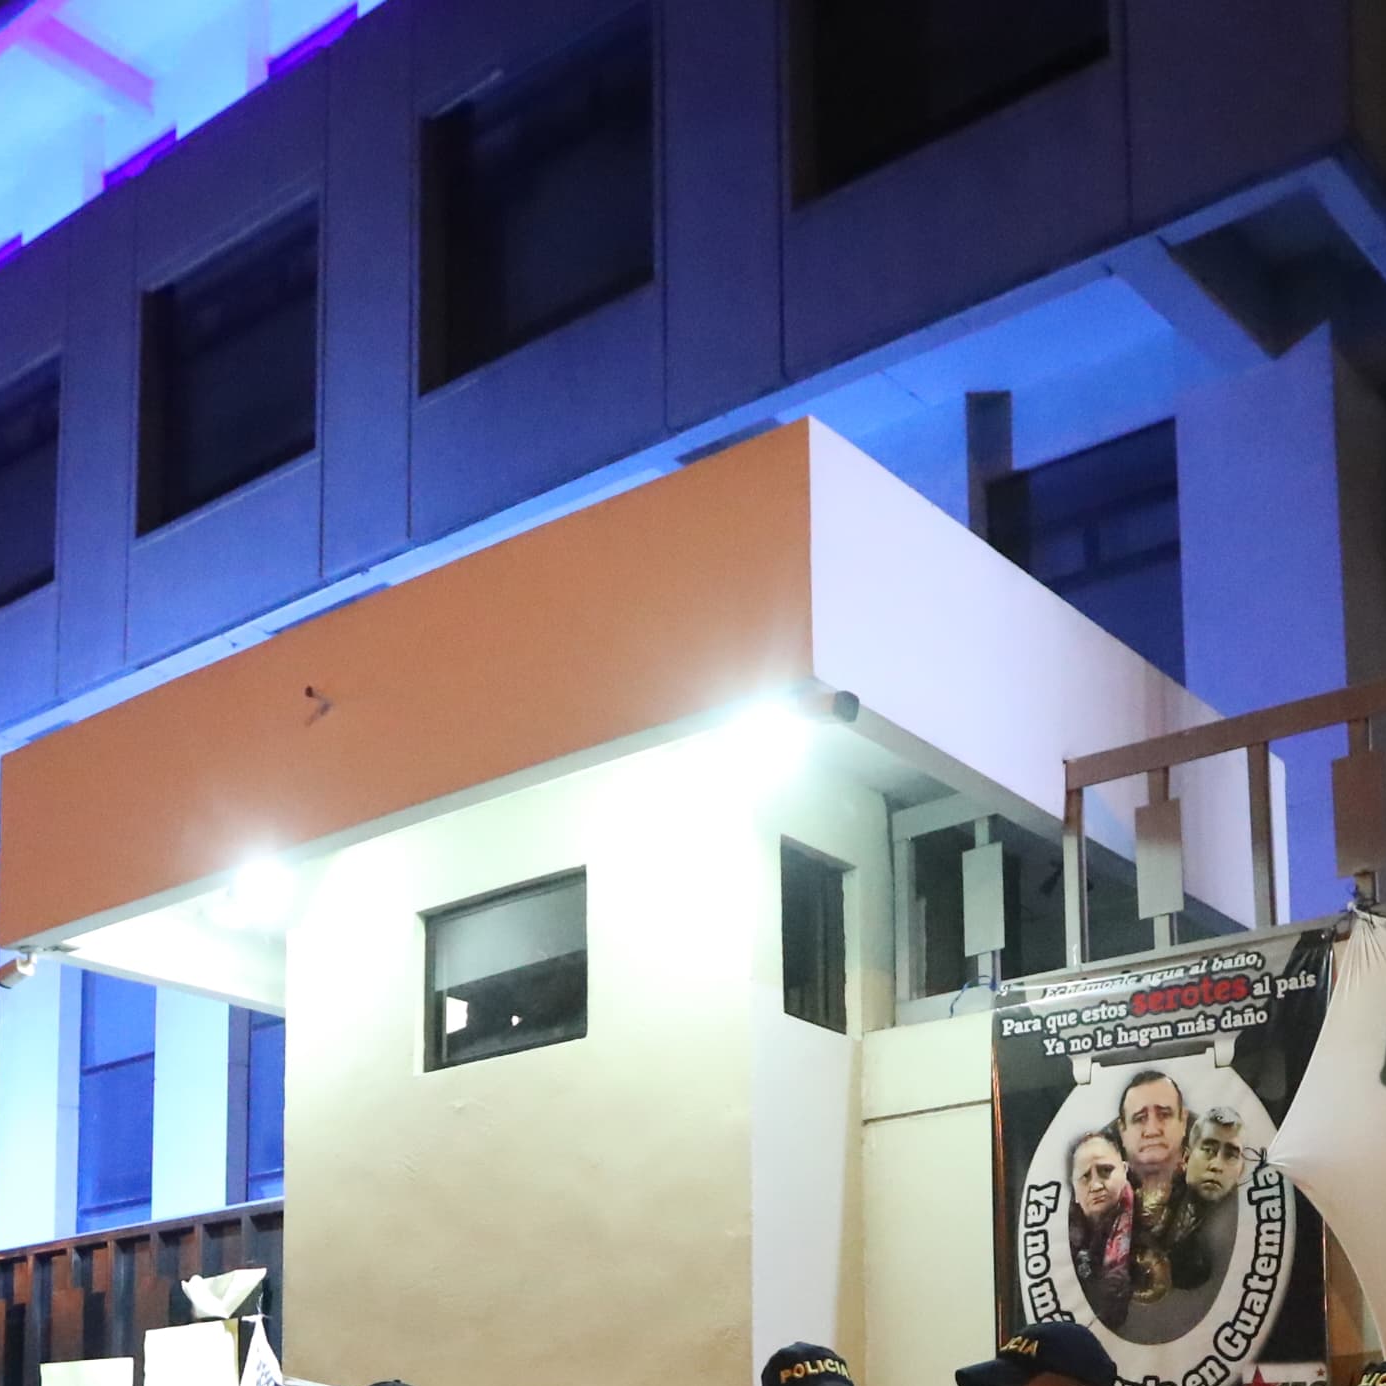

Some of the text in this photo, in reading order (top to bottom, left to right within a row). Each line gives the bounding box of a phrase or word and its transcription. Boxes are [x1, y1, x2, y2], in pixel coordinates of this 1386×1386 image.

[1140, 966, 1186, 988] agua
[1188, 959, 1208, 976] al
[1211, 952, 1263, 971] baño,
[1002, 970, 1317, 1036] Para que estos serotes al país
[1043, 1007, 1268, 1056] Ya no le hagan más daño
[1024, 1181, 1061, 1228] Ya
[1024, 1229, 1051, 1279] no
[1213, 1163, 1287, 1362] Guatemala
[779, 1358, 850, 1385] POLICIA
